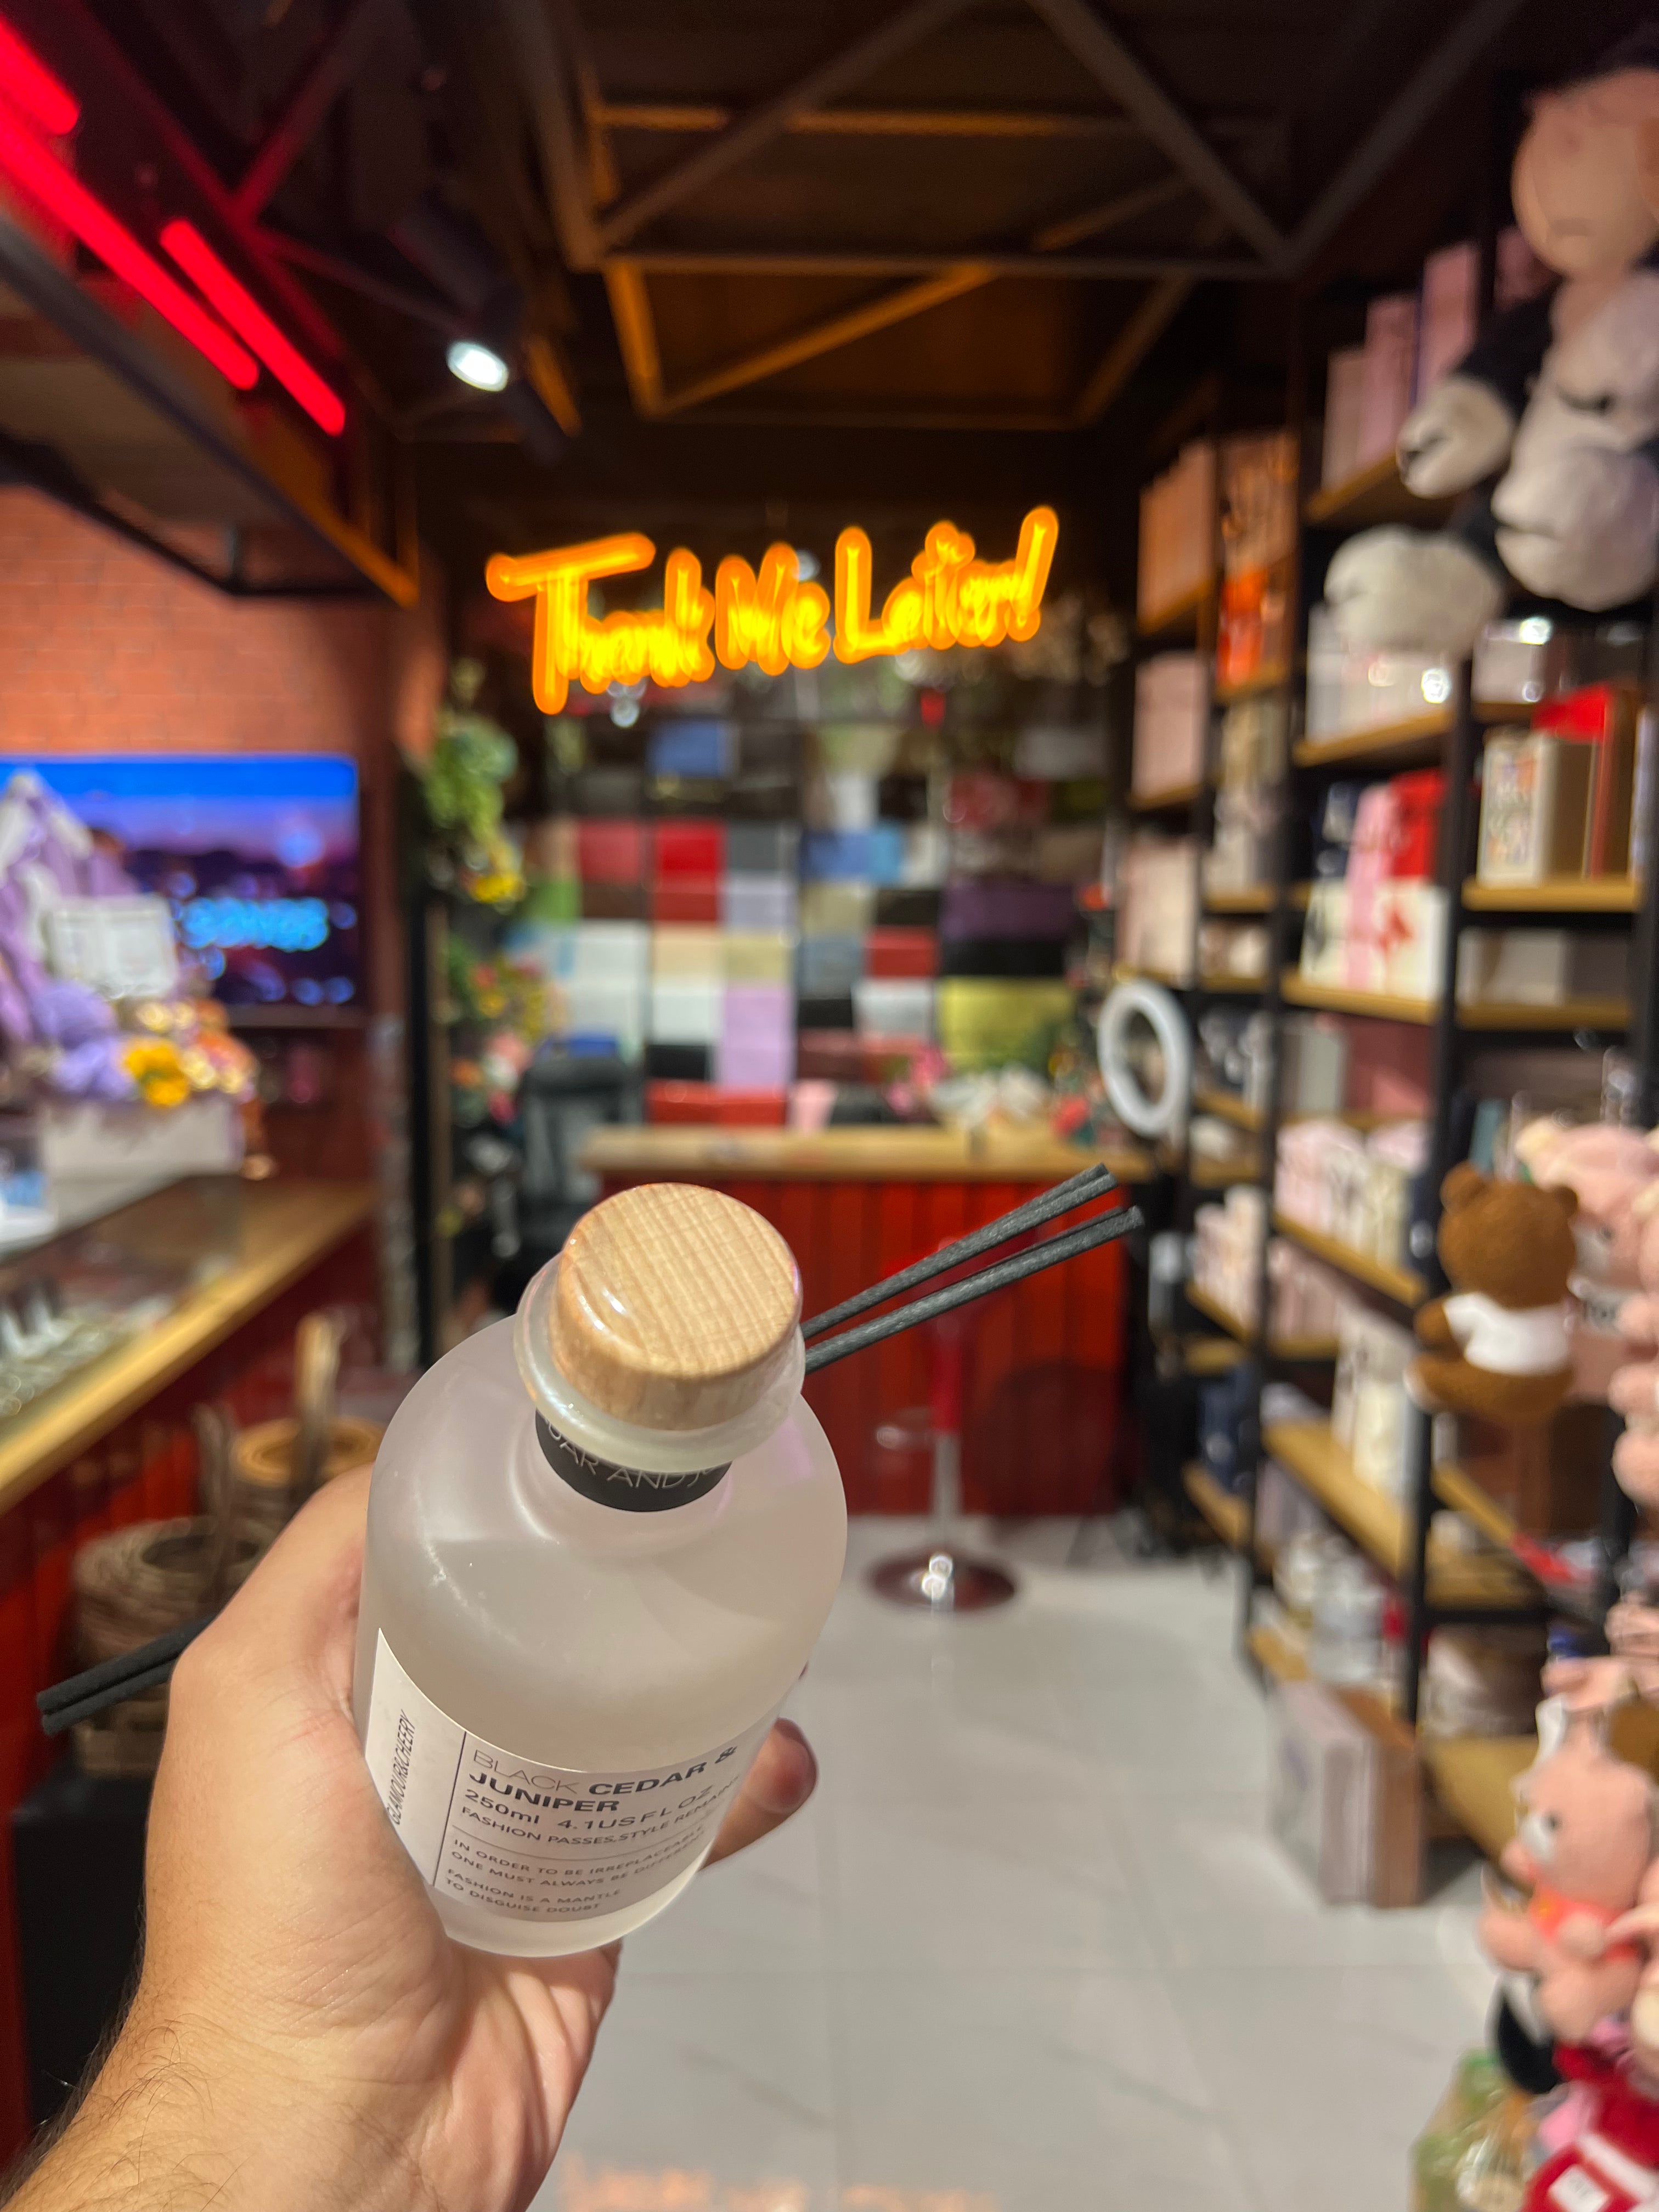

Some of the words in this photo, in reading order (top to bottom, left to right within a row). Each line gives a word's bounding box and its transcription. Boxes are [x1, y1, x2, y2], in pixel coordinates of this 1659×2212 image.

[606, 1466, 686, 1489] AND
[386, 1708, 416, 1826] GLAMOUR&CHEERY
[473, 1749, 580, 1795] BLACK
[588, 1761, 708, 1795] CEDAR
[714, 1745, 738, 1764] &
[465, 1788, 540, 1824] 250ml
[678, 1785, 713, 1809] OZ
[469, 1772, 620, 1812] JUNIPER
[462, 1806, 541, 1841] FASHION
[452, 1850, 484, 1871] ONE
[489, 1867, 535, 1883] MUST
[540, 1877, 605, 1886] ALWAYS
[610, 1872, 629, 1881] BE
[454, 1839, 470, 1852] IN
[476, 1850, 530, 1872] ORDER
[538, 1867, 558, 1875] TO
[446, 1877, 464, 1891] TO
[469, 1890, 540, 1912] DISGUISE
[546, 1903, 601, 1913] DOUBT
[448, 1868, 515, 1898] FASHION
[556, 1888, 620, 1903] MANTLE
